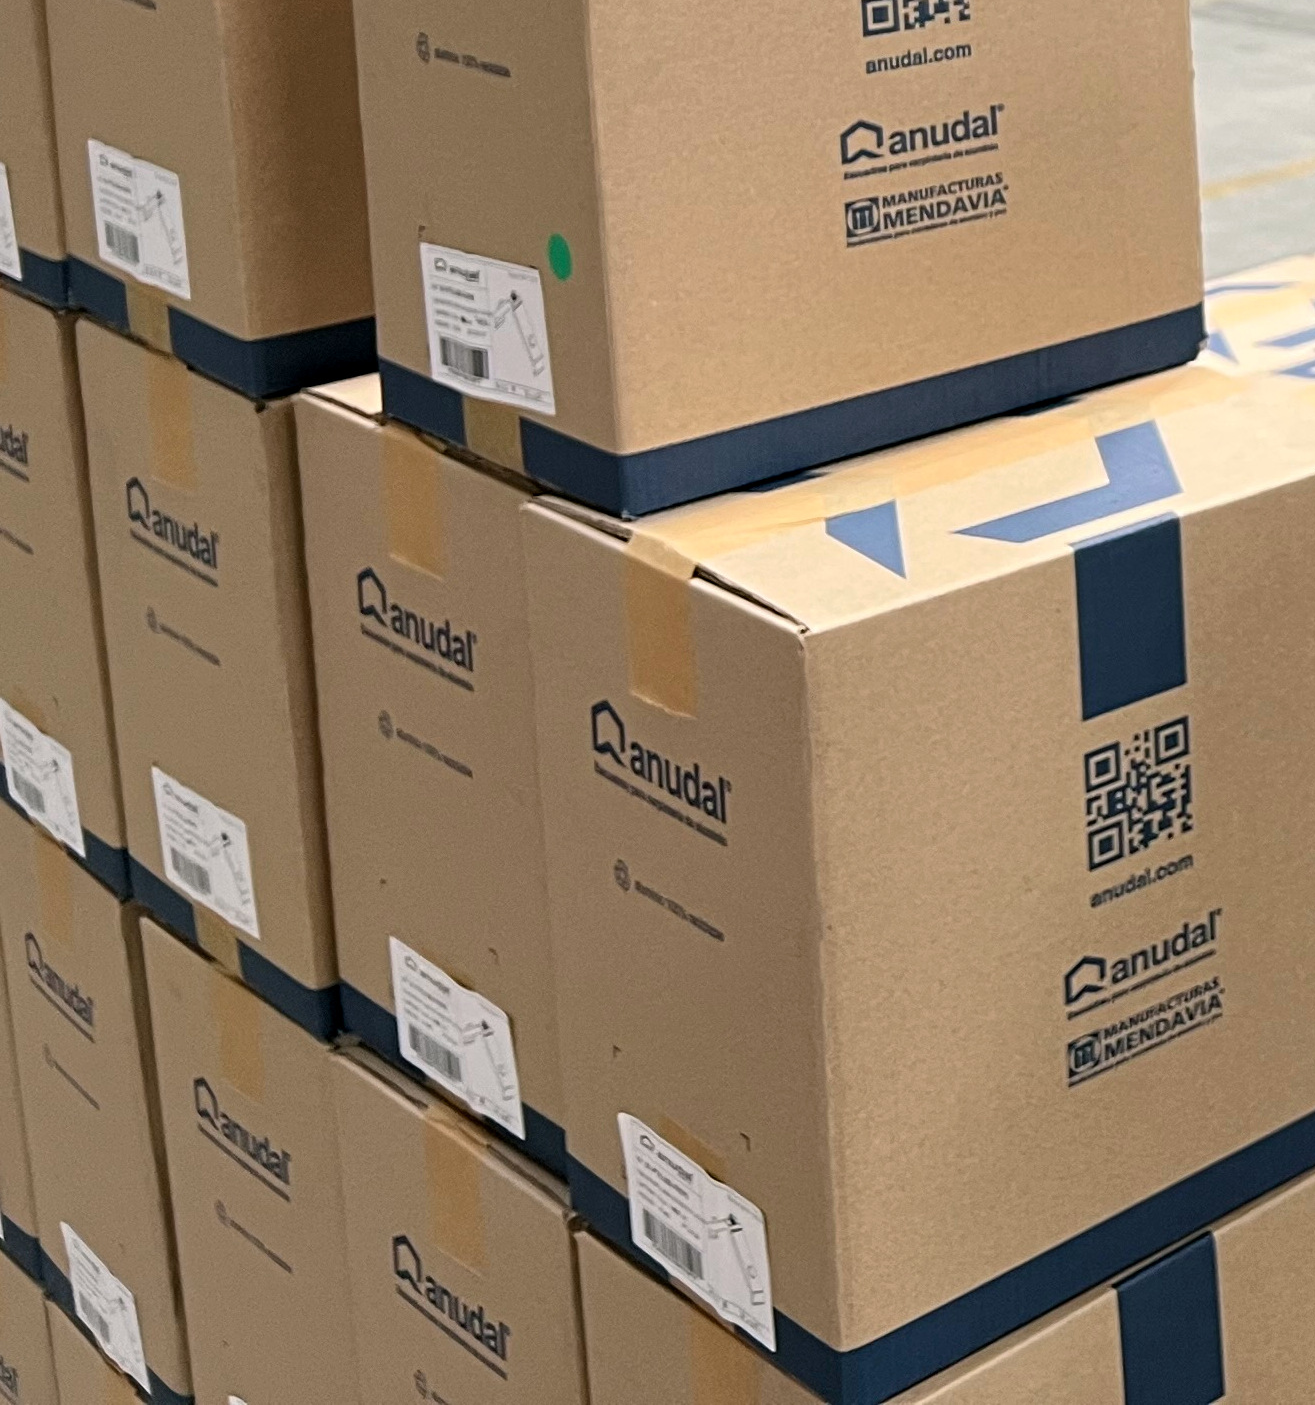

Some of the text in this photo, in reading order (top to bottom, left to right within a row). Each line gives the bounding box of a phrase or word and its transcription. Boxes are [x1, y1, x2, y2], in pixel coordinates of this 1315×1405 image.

[865, 44, 972, 74] anudal.com
[888, 104, 1001, 155] anudal
[881, 171, 1004, 208] MANUFACTURAS
[883, 188, 1006, 231] MENDAVIA
[391, 602, 475, 672] anudal
[630, 741, 729, 824] anudal
[1090, 853, 1194, 908] anudal.com
[1110, 909, 1218, 985] anudal
[1103, 977, 1221, 1040] MANUFACTURAS
[1104, 992, 1223, 1062] MENDAVIA
